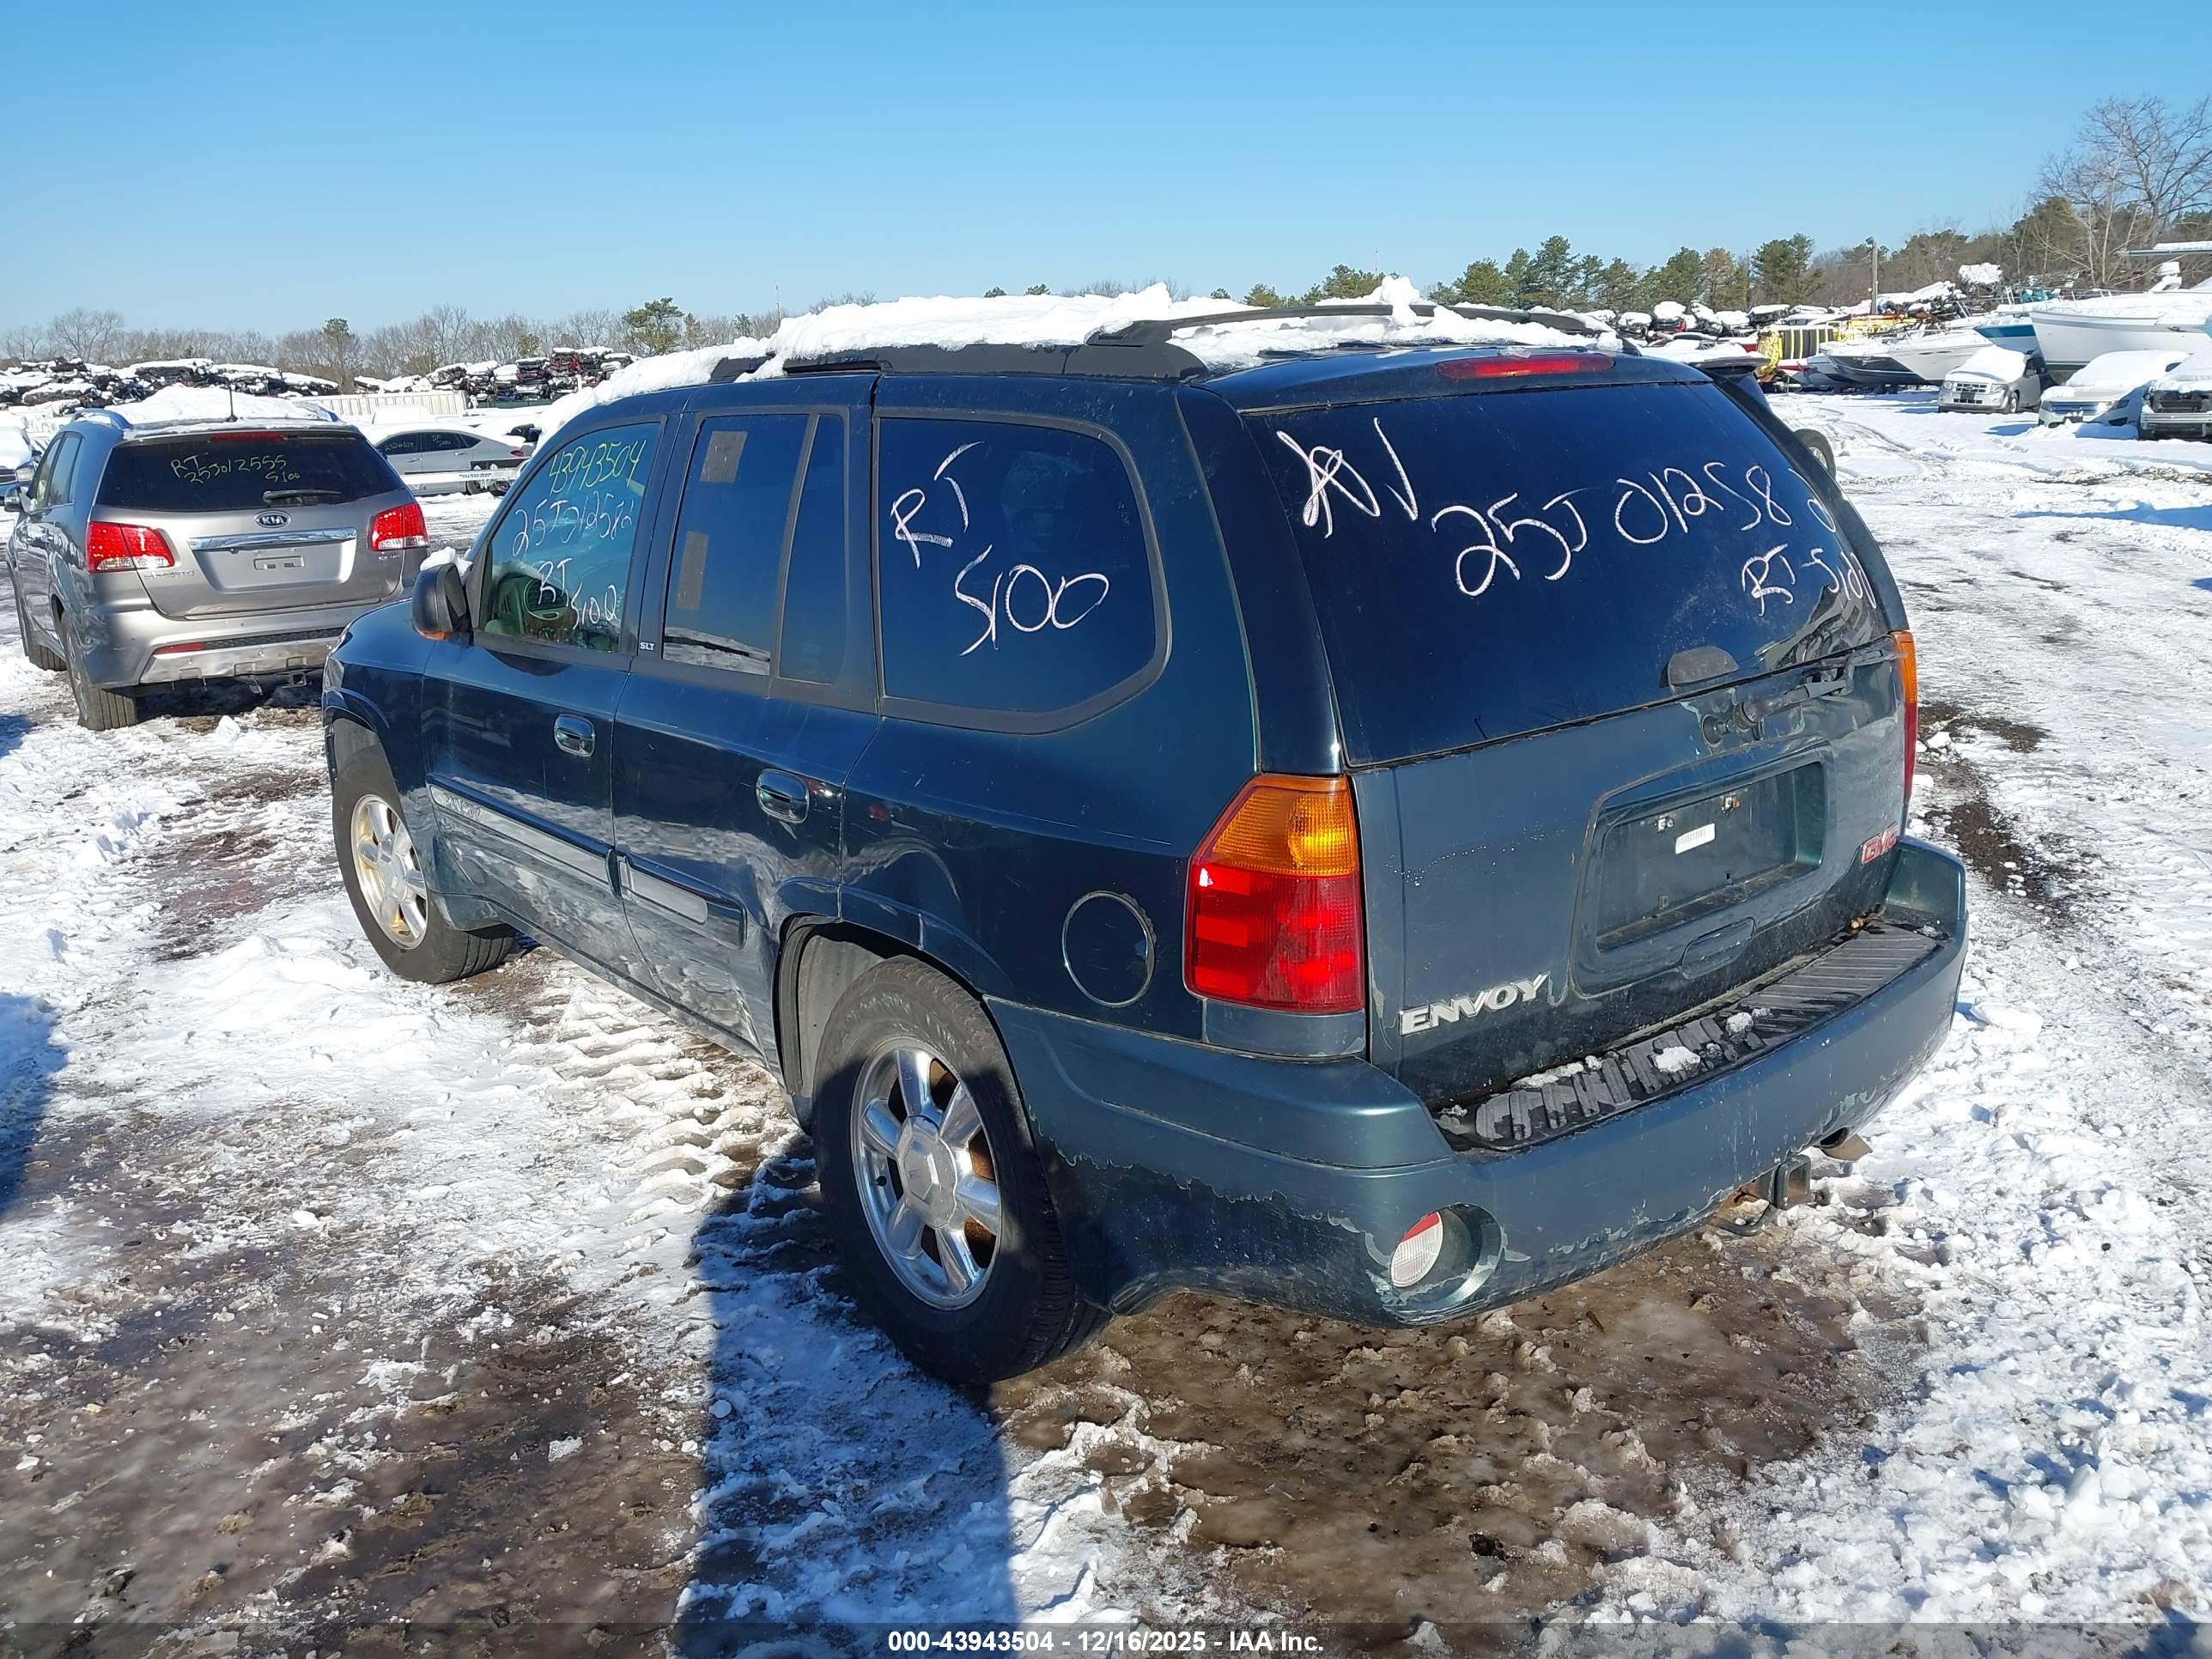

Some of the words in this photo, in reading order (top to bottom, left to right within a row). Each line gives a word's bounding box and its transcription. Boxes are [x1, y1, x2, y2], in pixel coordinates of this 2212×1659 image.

[550, 439, 647, 496] 43943504
[261, 516, 286, 526] KIA
[640, 641, 654, 651] SLT
[1862, 823, 1899, 865] GMC
[1399, 970, 1551, 1036] ENVOY
